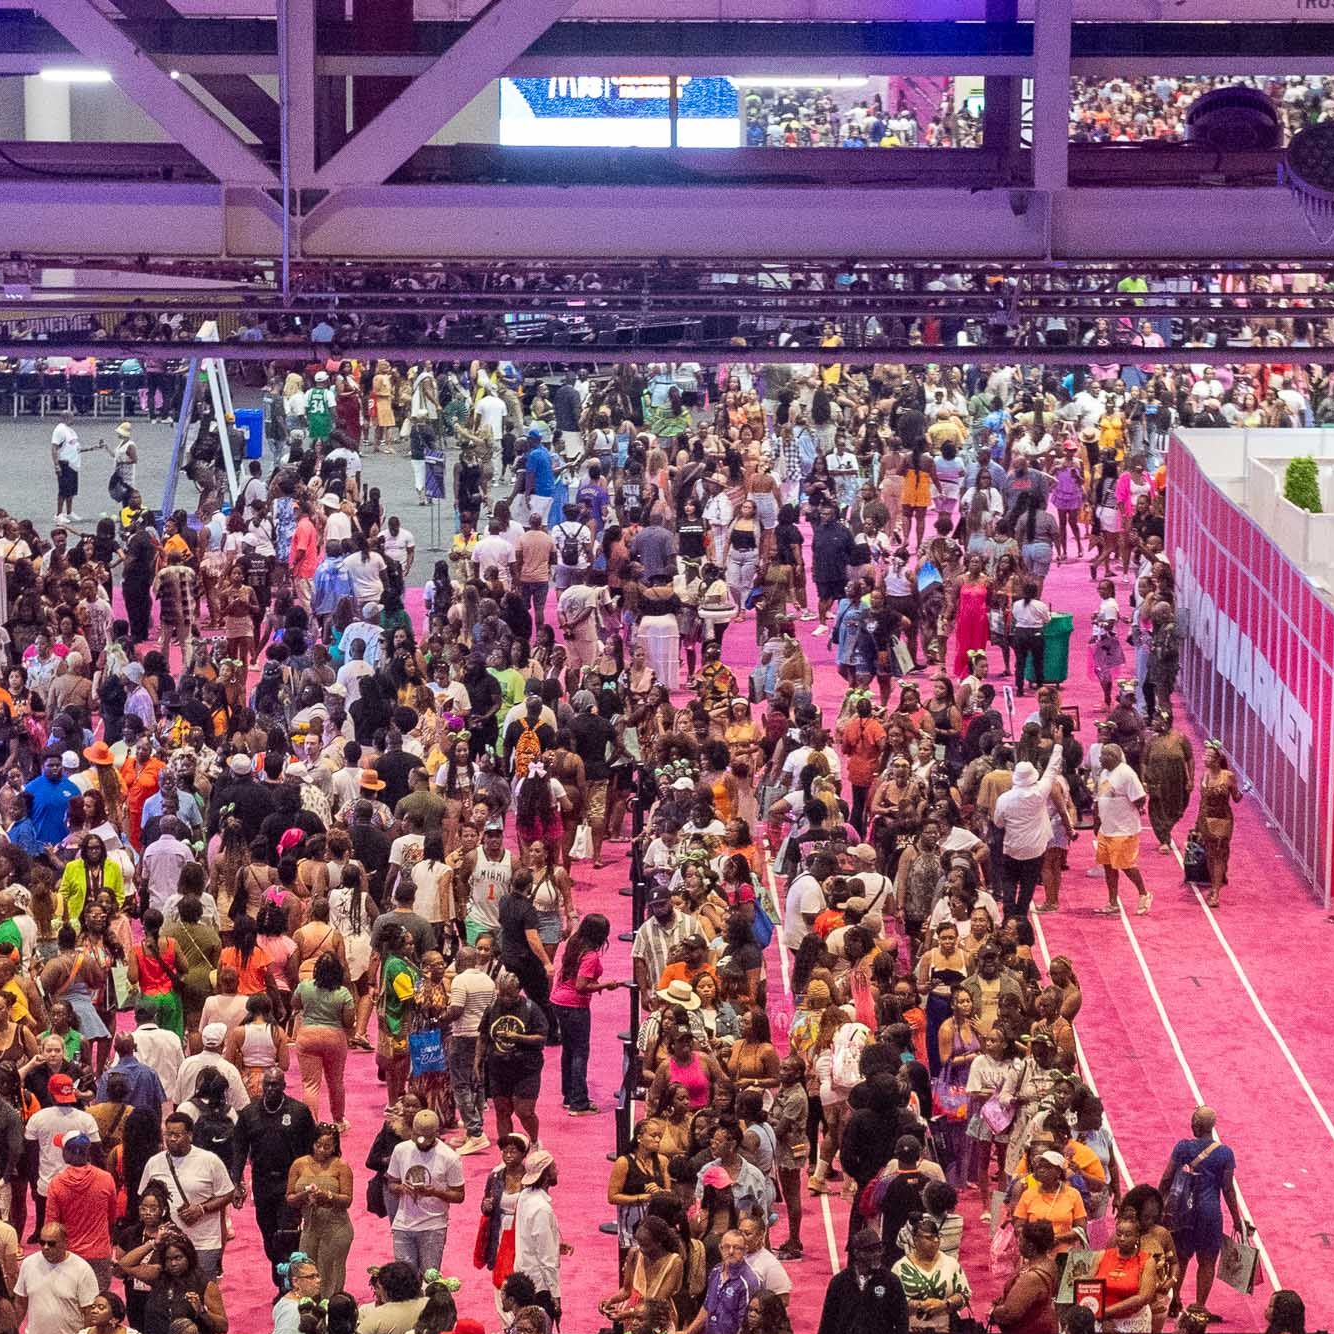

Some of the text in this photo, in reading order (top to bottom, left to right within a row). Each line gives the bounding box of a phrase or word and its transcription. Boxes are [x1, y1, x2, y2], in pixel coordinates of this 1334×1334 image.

[310, 399, 325, 414] 34
[1216, 607, 1314, 783] MARKET
[480, 870, 507, 882] MIAMI
[487, 883, 496, 901] 1
